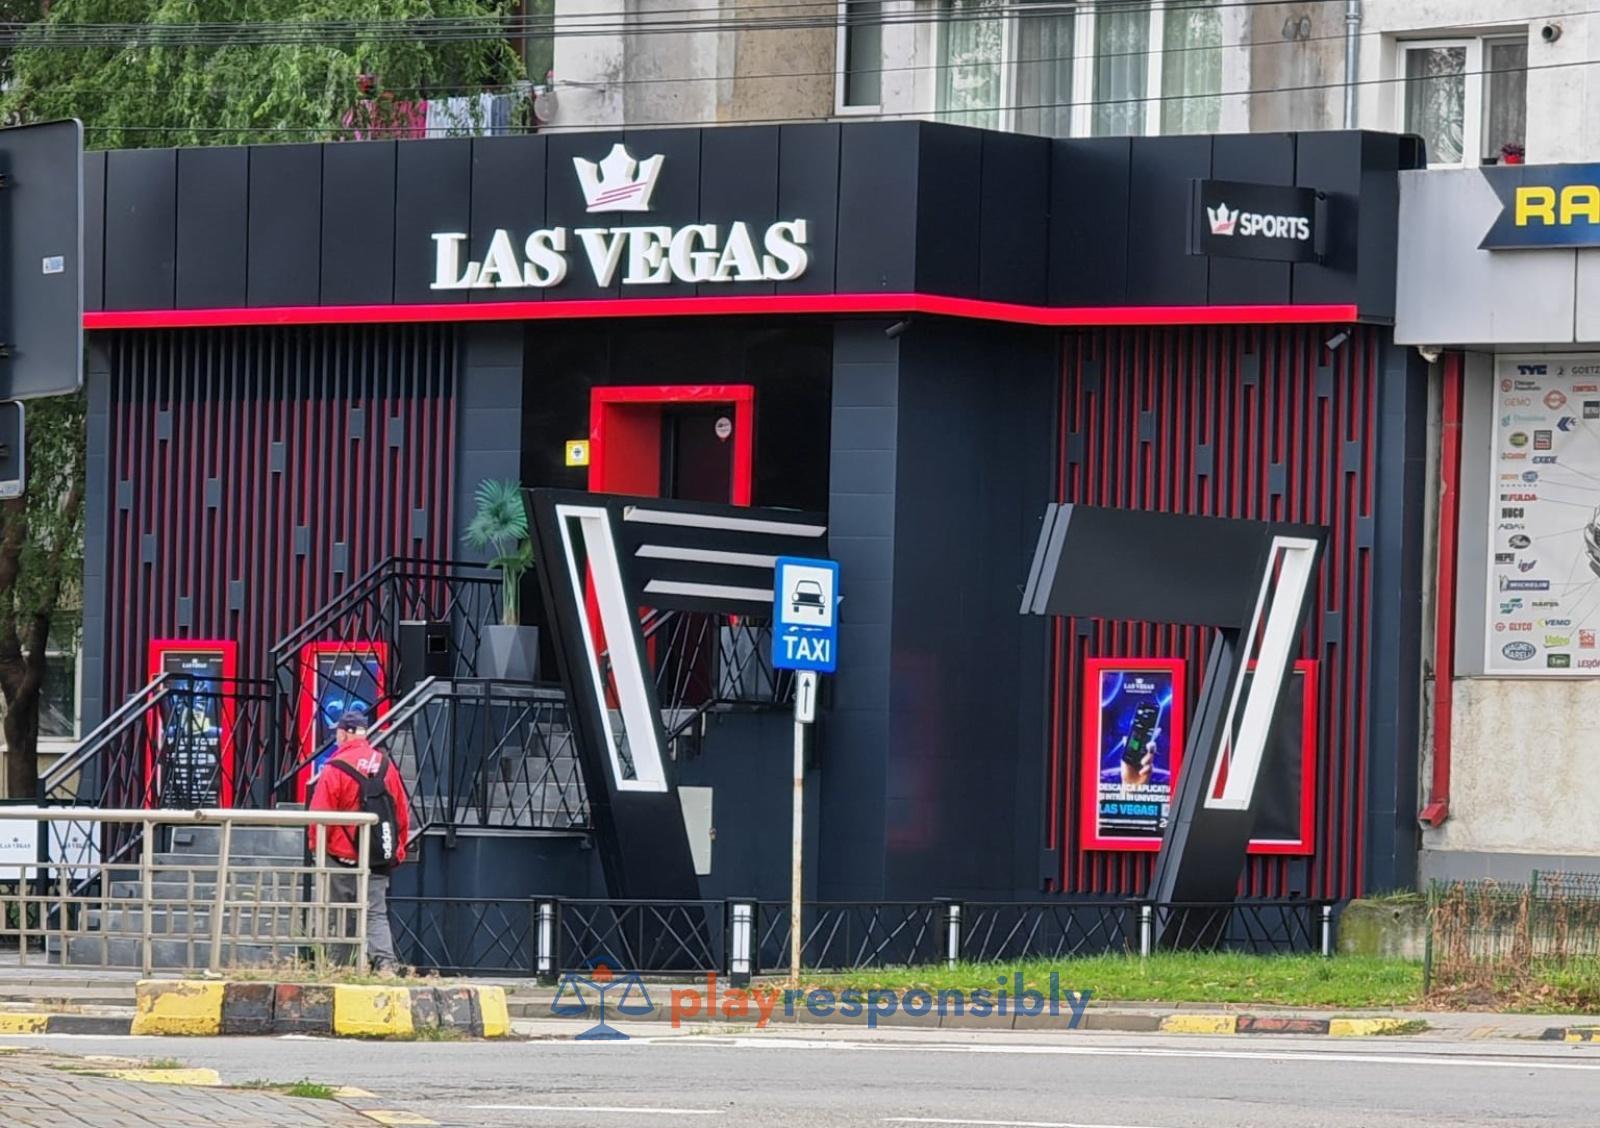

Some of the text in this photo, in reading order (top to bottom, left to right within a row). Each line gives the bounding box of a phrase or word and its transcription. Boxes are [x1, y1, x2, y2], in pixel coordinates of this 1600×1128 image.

[1515, 185, 1600, 226] RA
[1240, 213, 1310, 240] SPORTS
[430, 219, 808, 289] LAS VEGAS
[782, 635, 830, 663] TAXI
[1578, 658, 1600, 669] LESJÖ
[1100, 804, 1158, 816] LAS VEGAS!
[382, 822, 392, 859] adidas
